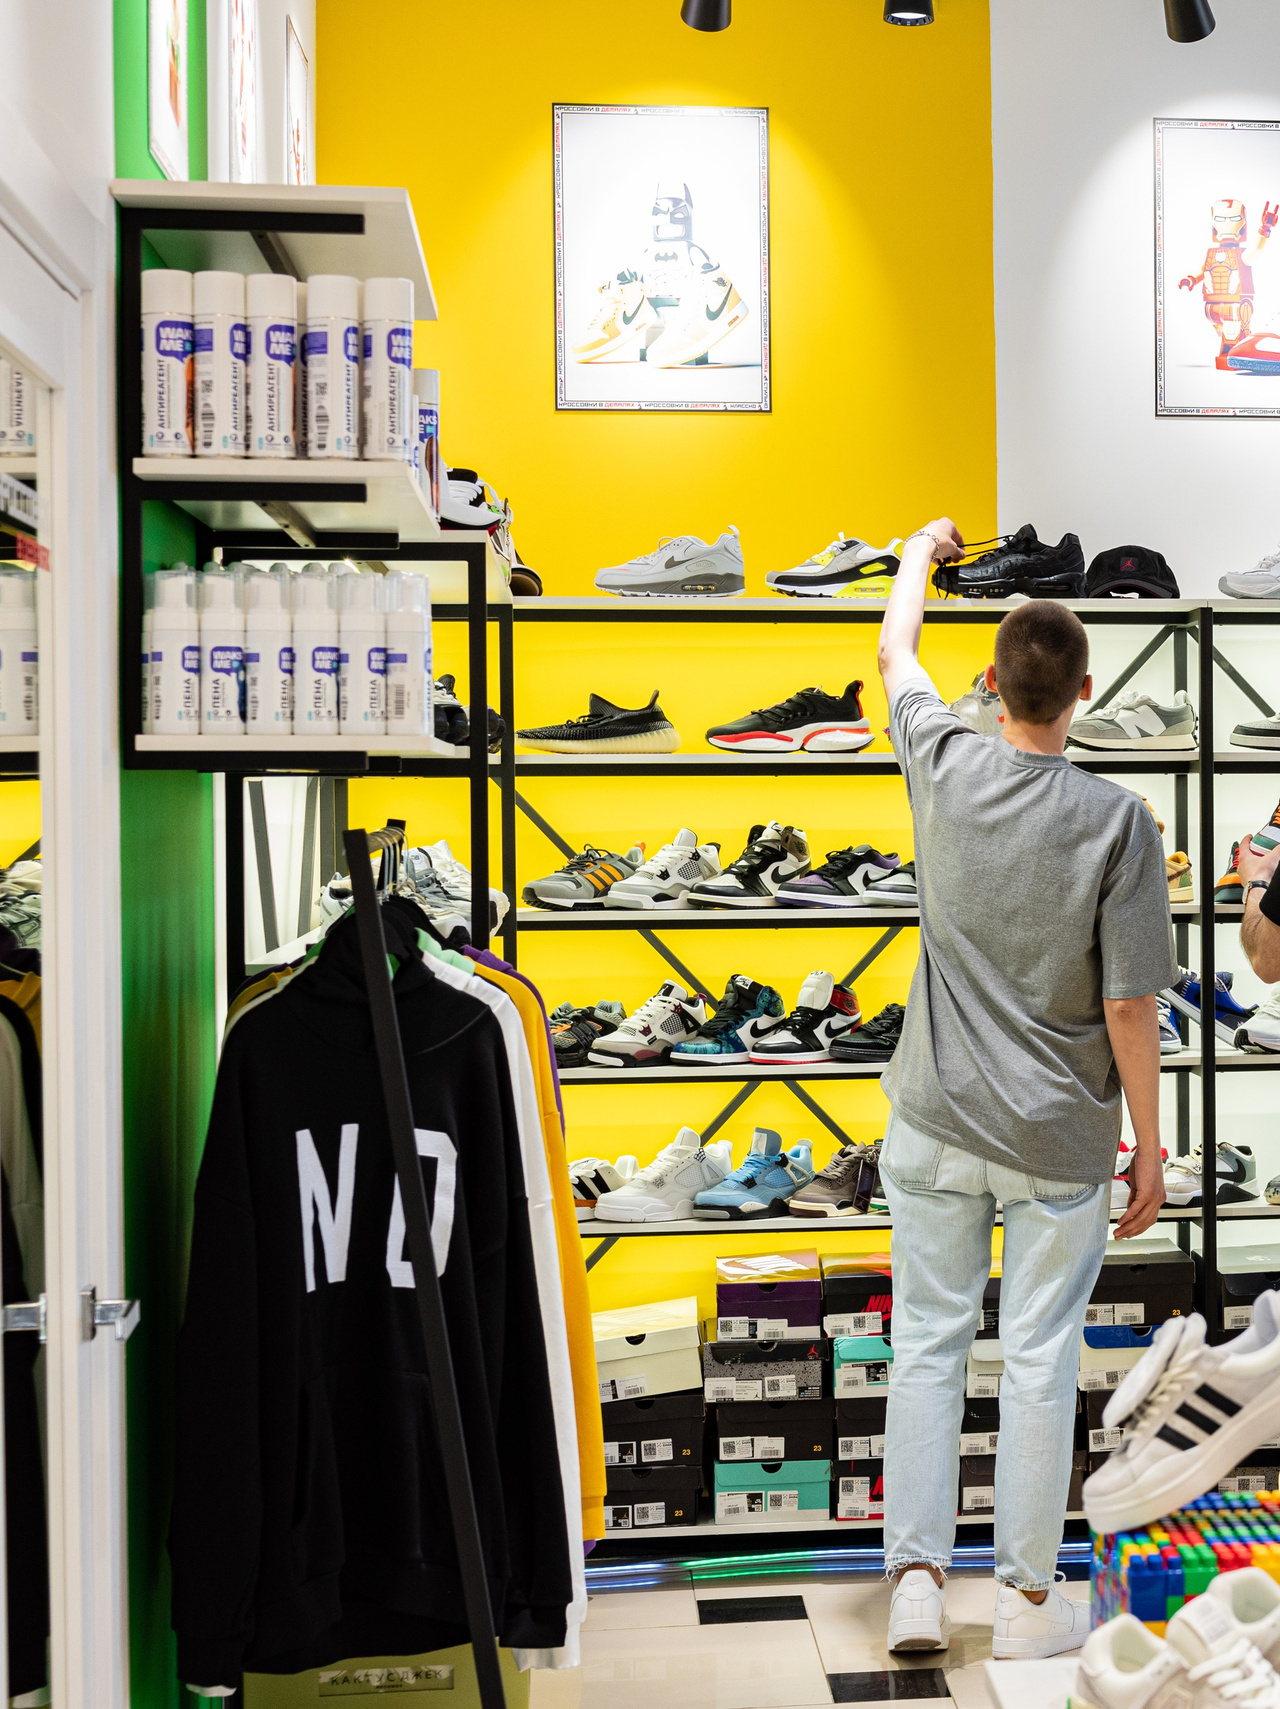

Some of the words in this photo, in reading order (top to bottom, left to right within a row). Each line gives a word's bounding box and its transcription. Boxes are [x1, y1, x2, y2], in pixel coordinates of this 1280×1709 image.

[157, 359, 165, 429] АНТИРЕАГЕНТ
[267, 363, 275, 431] АНТИРЕАГЕНТ
[388, 365, 397, 434] АНТИРЕАГЕНТ
[419, 415, 437, 425] AKS
[212, 678, 221, 708] ПЕНА
[314, 678, 322, 708] ПЕНА
[401, 1669, 443, 1681] ДЖЕК
